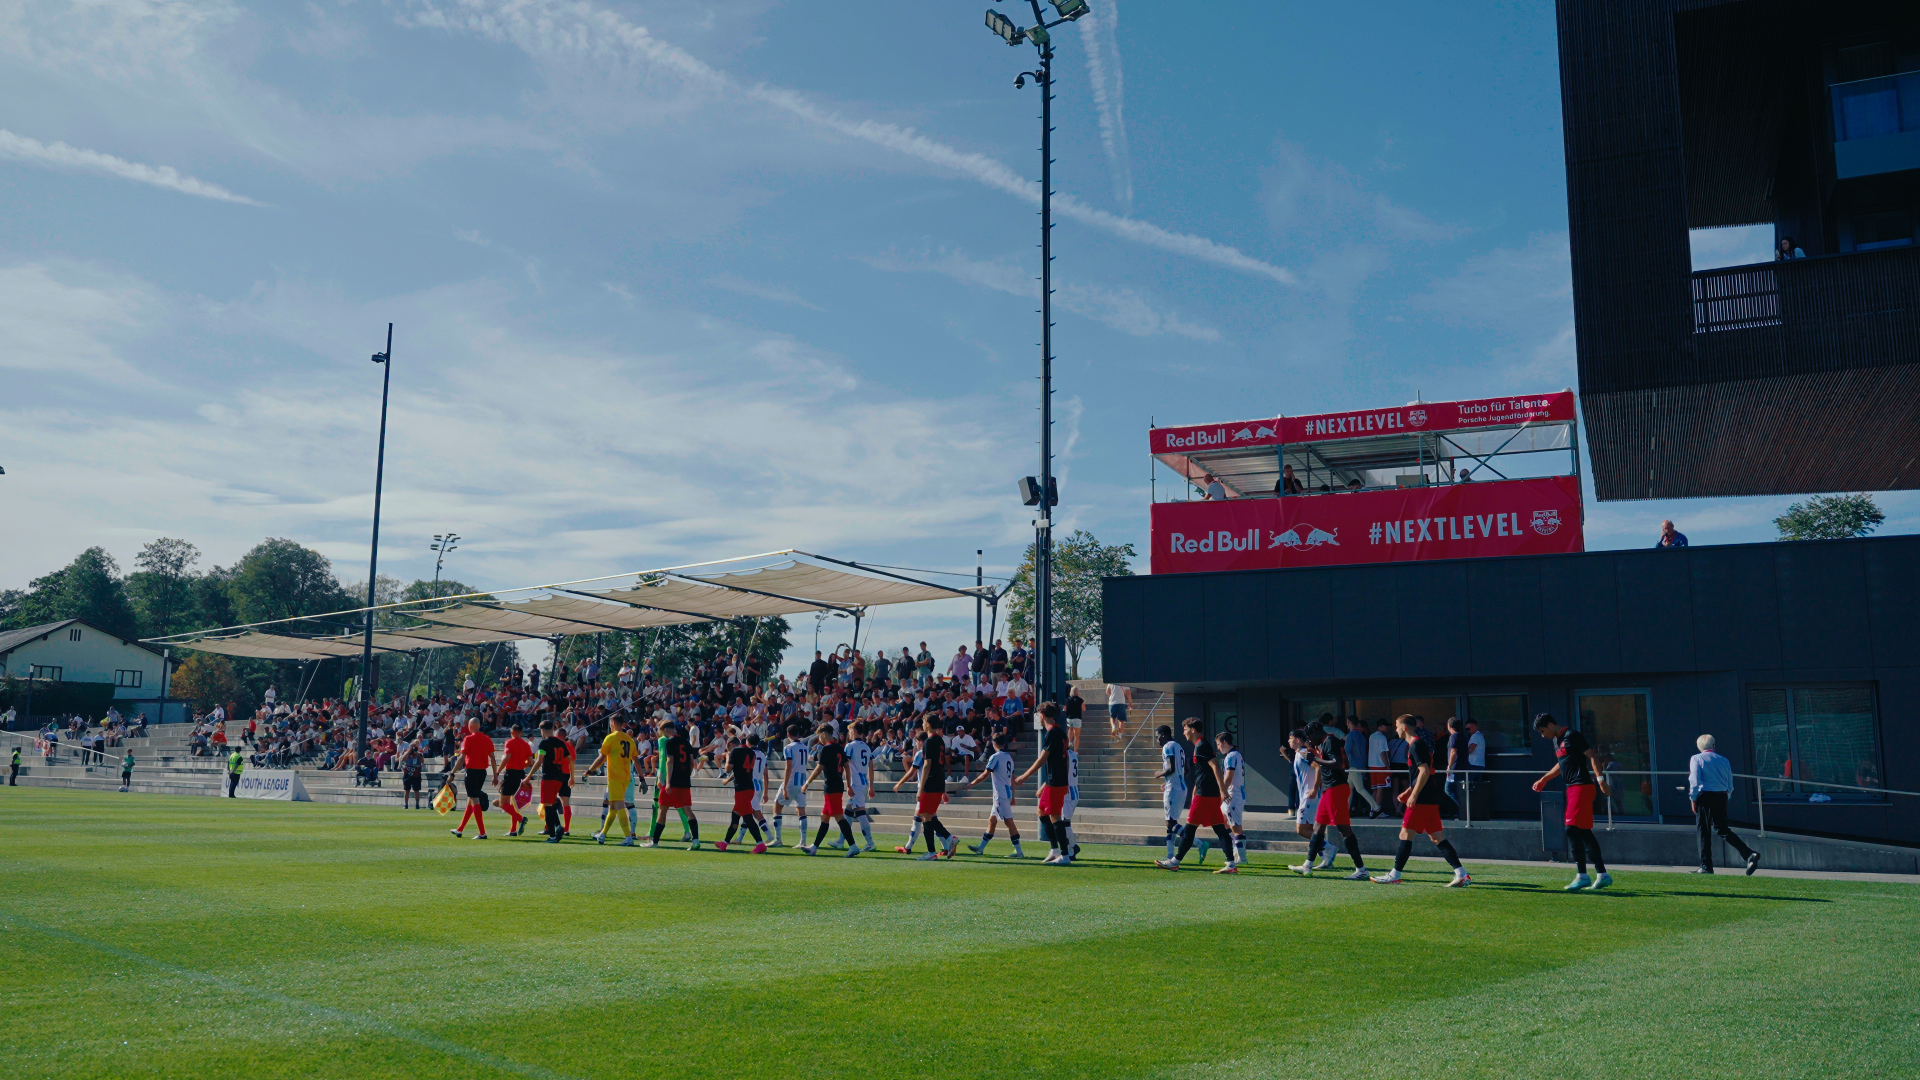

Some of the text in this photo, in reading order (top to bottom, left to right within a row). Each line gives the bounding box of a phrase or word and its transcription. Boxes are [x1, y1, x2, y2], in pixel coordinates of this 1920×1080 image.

[1458, 399, 1551, 414] Turbo für Talente.
[1305, 412, 1404, 435] #NEXTLEVEL
[1458, 416, 1487, 424] Porsche
[1166, 428, 1226, 448] Red Bull
[1368, 512, 1523, 545] #NEXTLEVEL
[1170, 528, 1260, 553] Red Bull
[552, 747, 565, 764] 10
[620, 740, 631, 759] 31
[679, 744, 687, 763] 5
[798, 748, 808, 766] 11
[860, 749, 868, 766] 5
[756, 756, 762, 773] 7
[1006, 760, 1012, 779] 9
[1072, 758, 1078, 777] 3
[240, 777, 263, 790] YOUTH
[263, 778, 290, 791] LEAGUE
